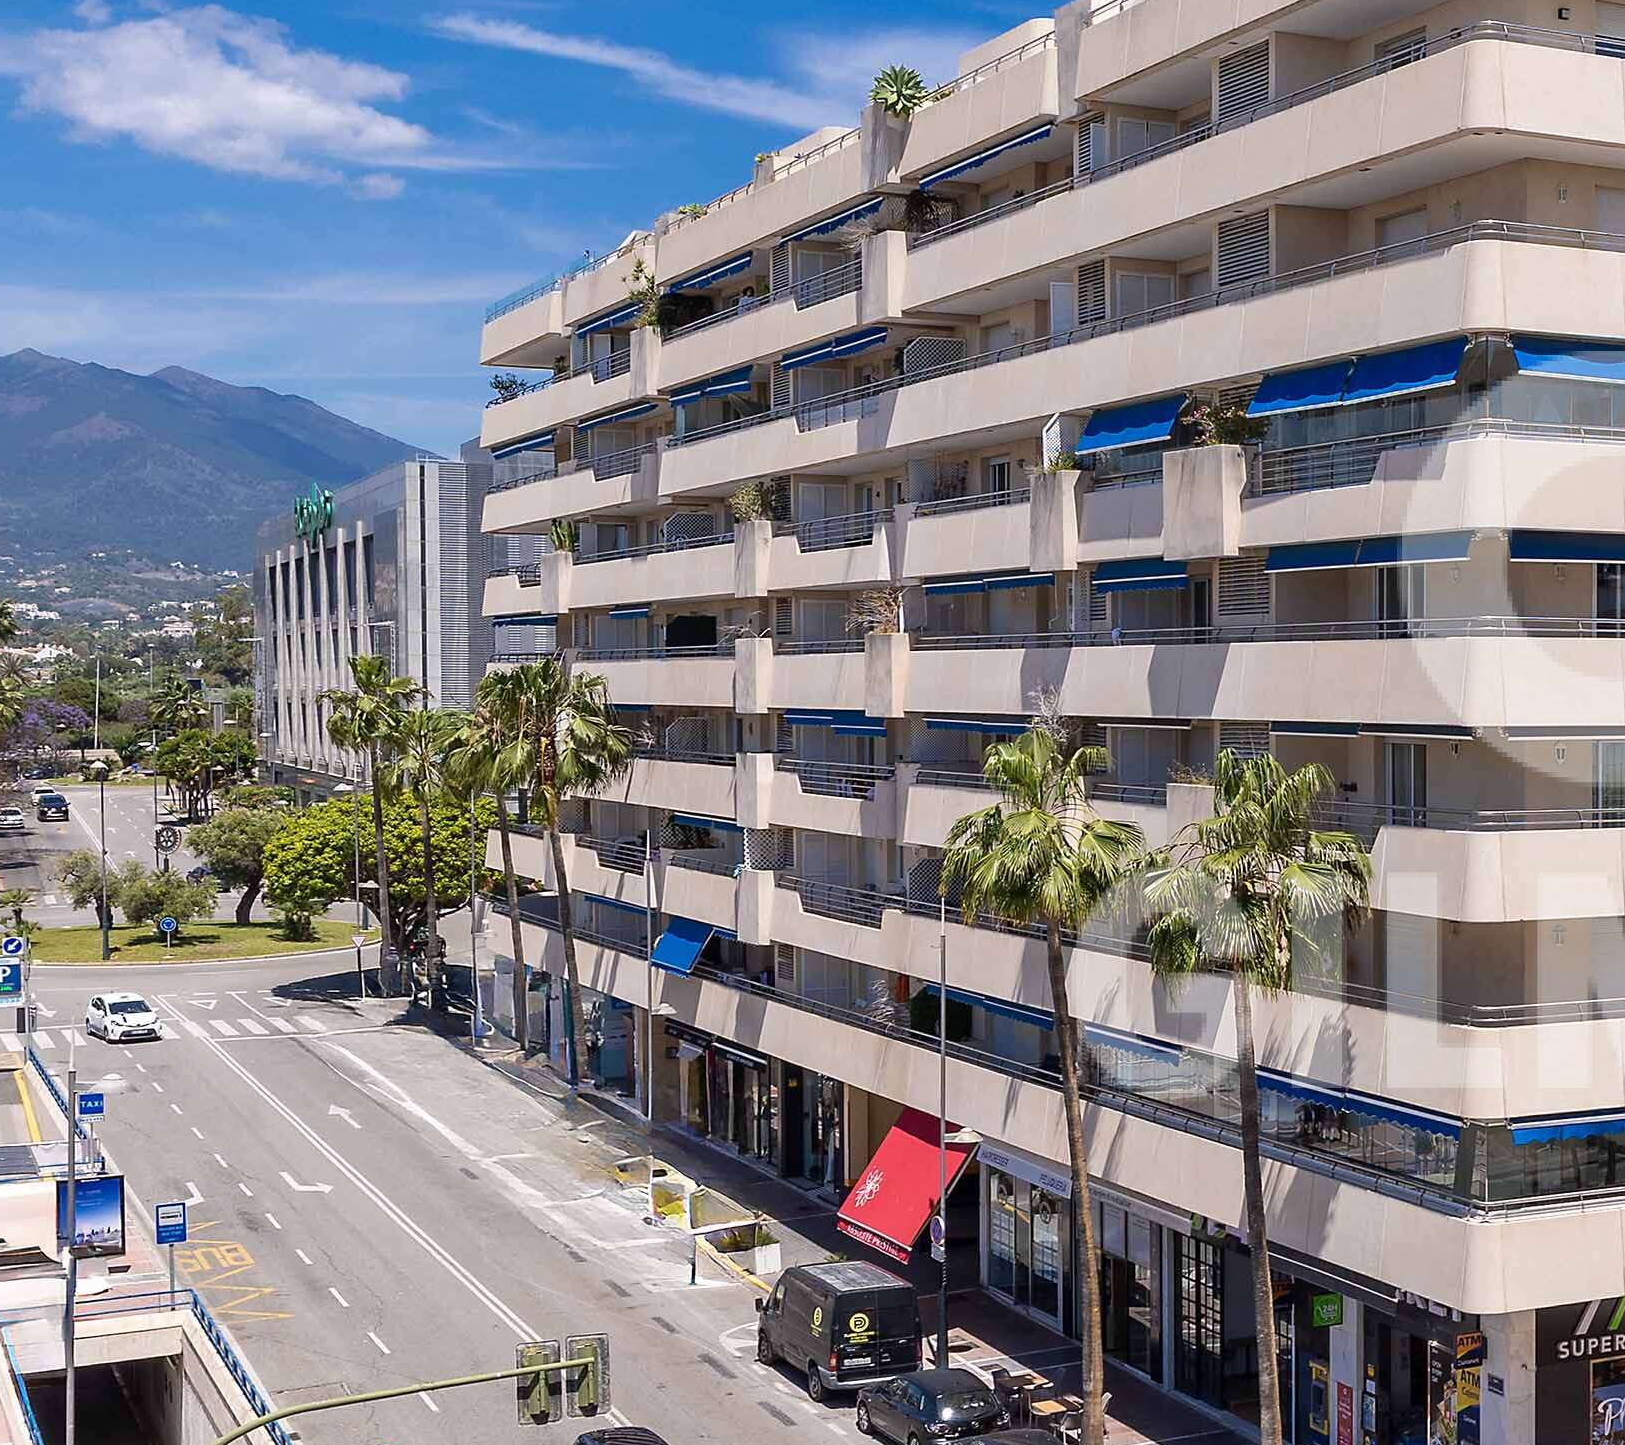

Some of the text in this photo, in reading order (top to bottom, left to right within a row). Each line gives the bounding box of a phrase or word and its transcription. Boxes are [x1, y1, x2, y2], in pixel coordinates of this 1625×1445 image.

[79, 1100, 103, 1109] TAXI
[1456, 1335, 1482, 1349] ATM
[1460, 1369, 1481, 1386] ATM
